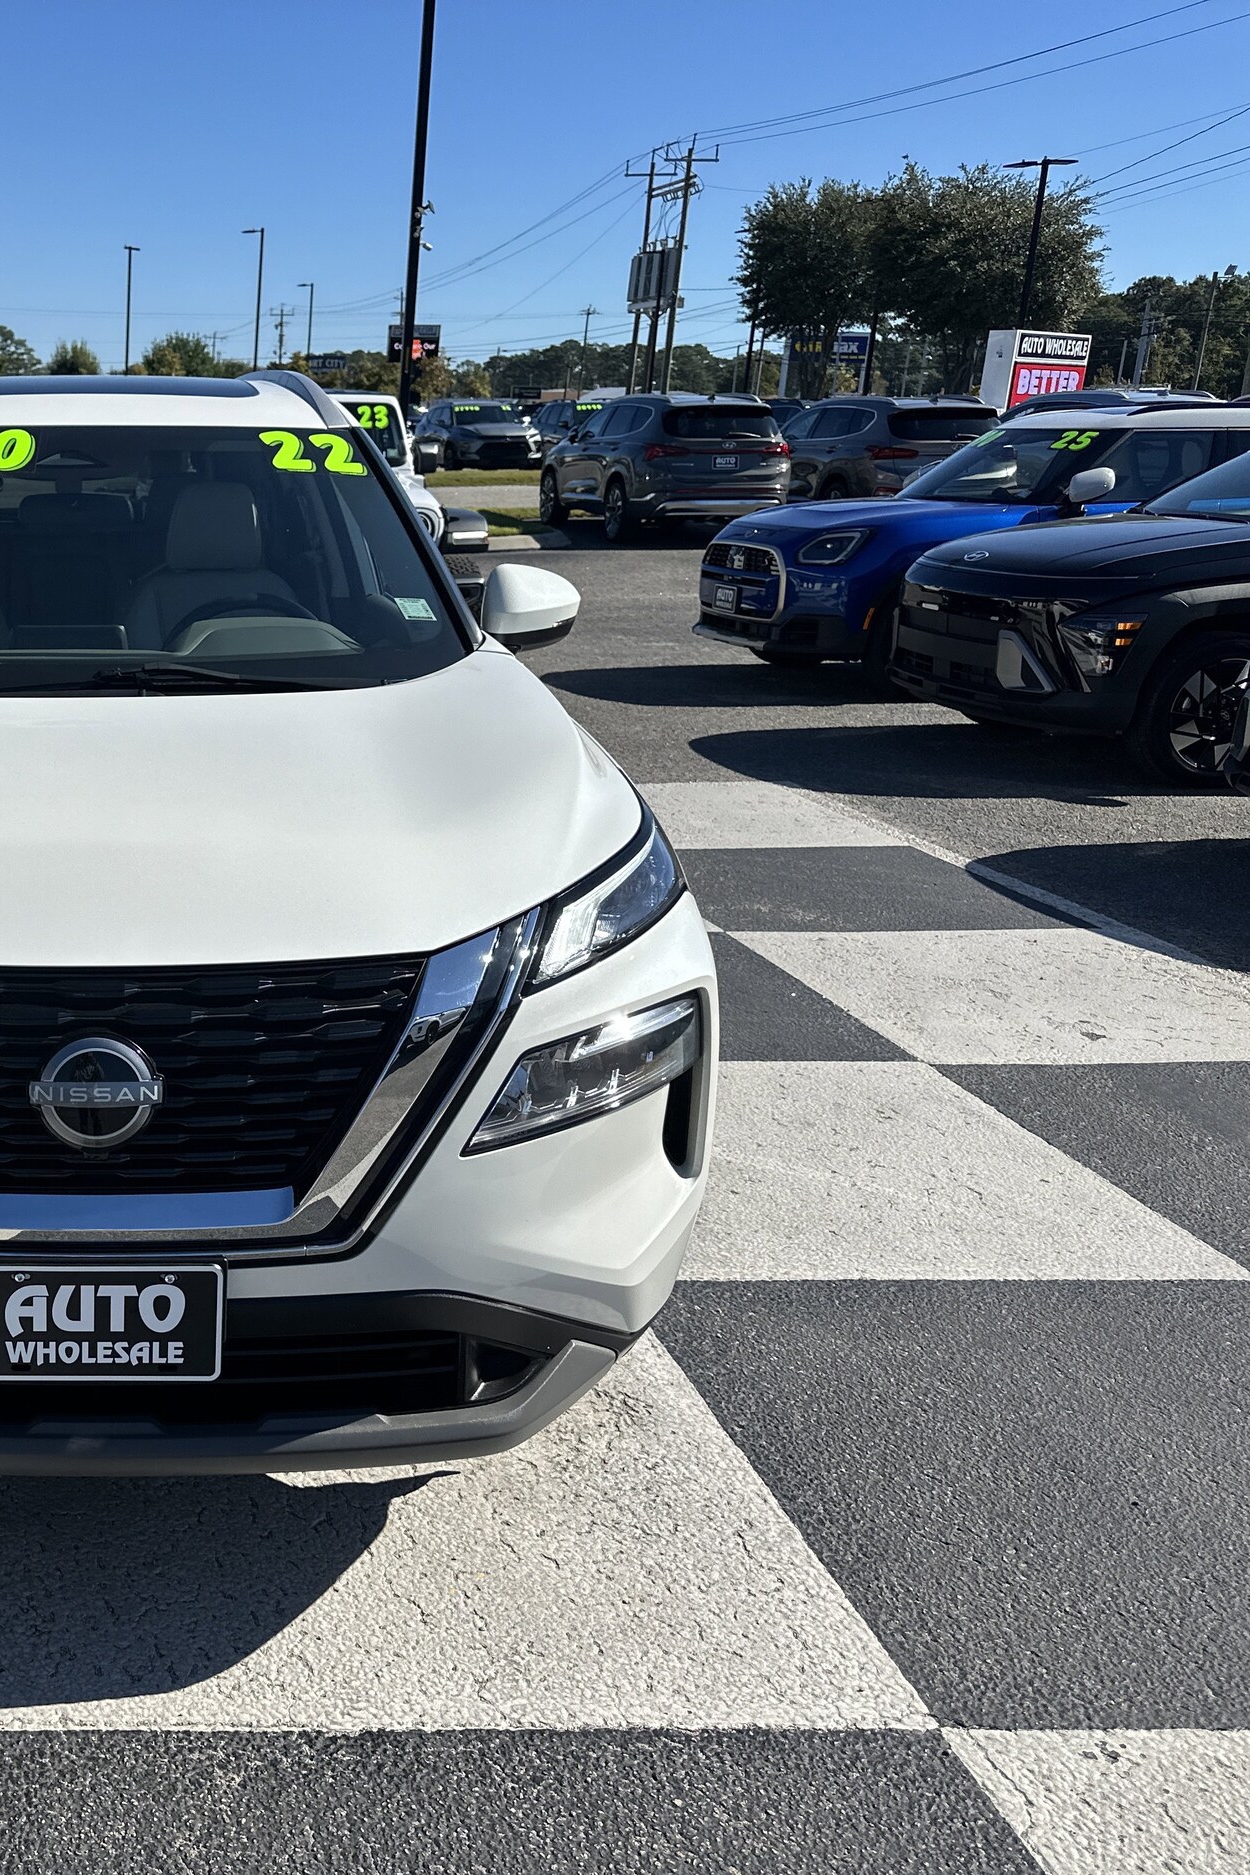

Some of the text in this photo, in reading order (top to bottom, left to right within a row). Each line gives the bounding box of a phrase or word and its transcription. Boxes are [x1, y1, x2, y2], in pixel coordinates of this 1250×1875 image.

[1020, 337, 1089, 358] AUTO WHOLESALE
[1016, 368, 1080, 395] BETTER
[356, 405, 390, 430] 23
[1050, 430, 1100, 451] 25
[257, 430, 369, 477] 22
[716, 587, 734, 602] AUTO
[32, 1085, 159, 1103] NISSAN
[4, 1283, 186, 1338] AUTO
[4, 1340, 185, 1367] WHOLESALE
